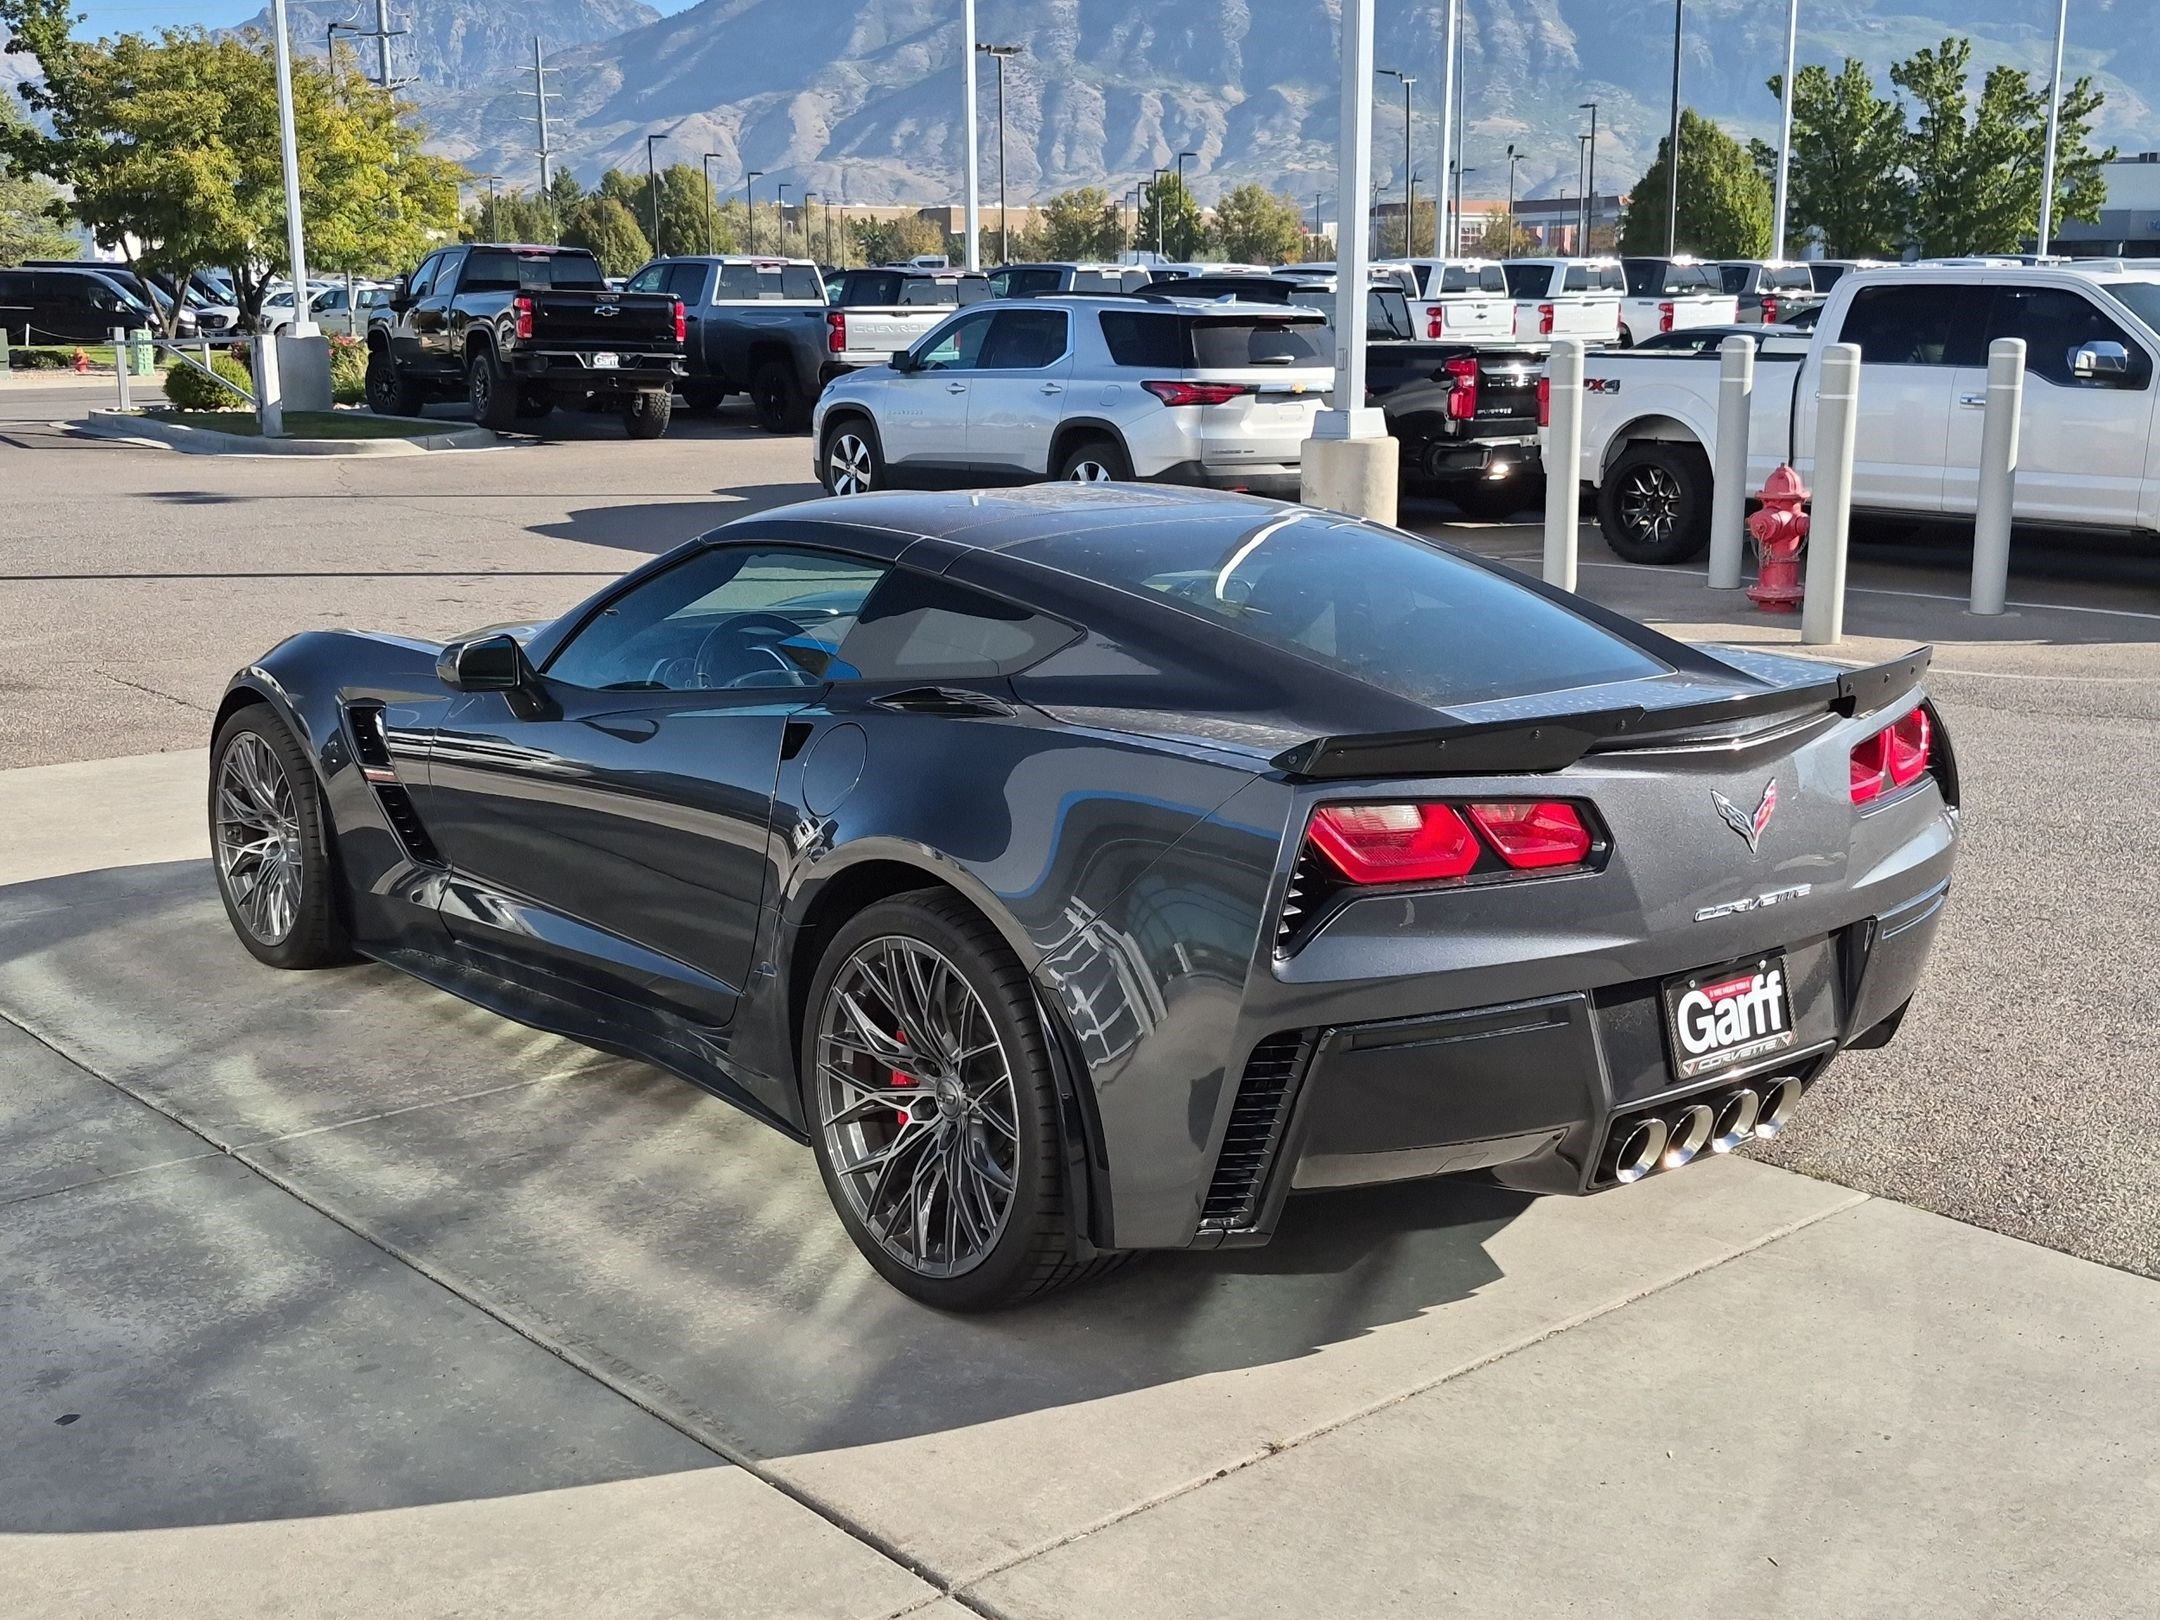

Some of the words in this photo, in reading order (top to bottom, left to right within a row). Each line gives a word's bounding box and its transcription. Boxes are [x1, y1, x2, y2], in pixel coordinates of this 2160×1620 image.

[853, 323, 930, 334] CHEVROL
[593, 354, 619, 366] Garff
[1695, 883, 1811, 921] CORVETTE
[1677, 969, 1783, 1054] Garff
[1698, 1039, 1778, 1070] CORVETTE
